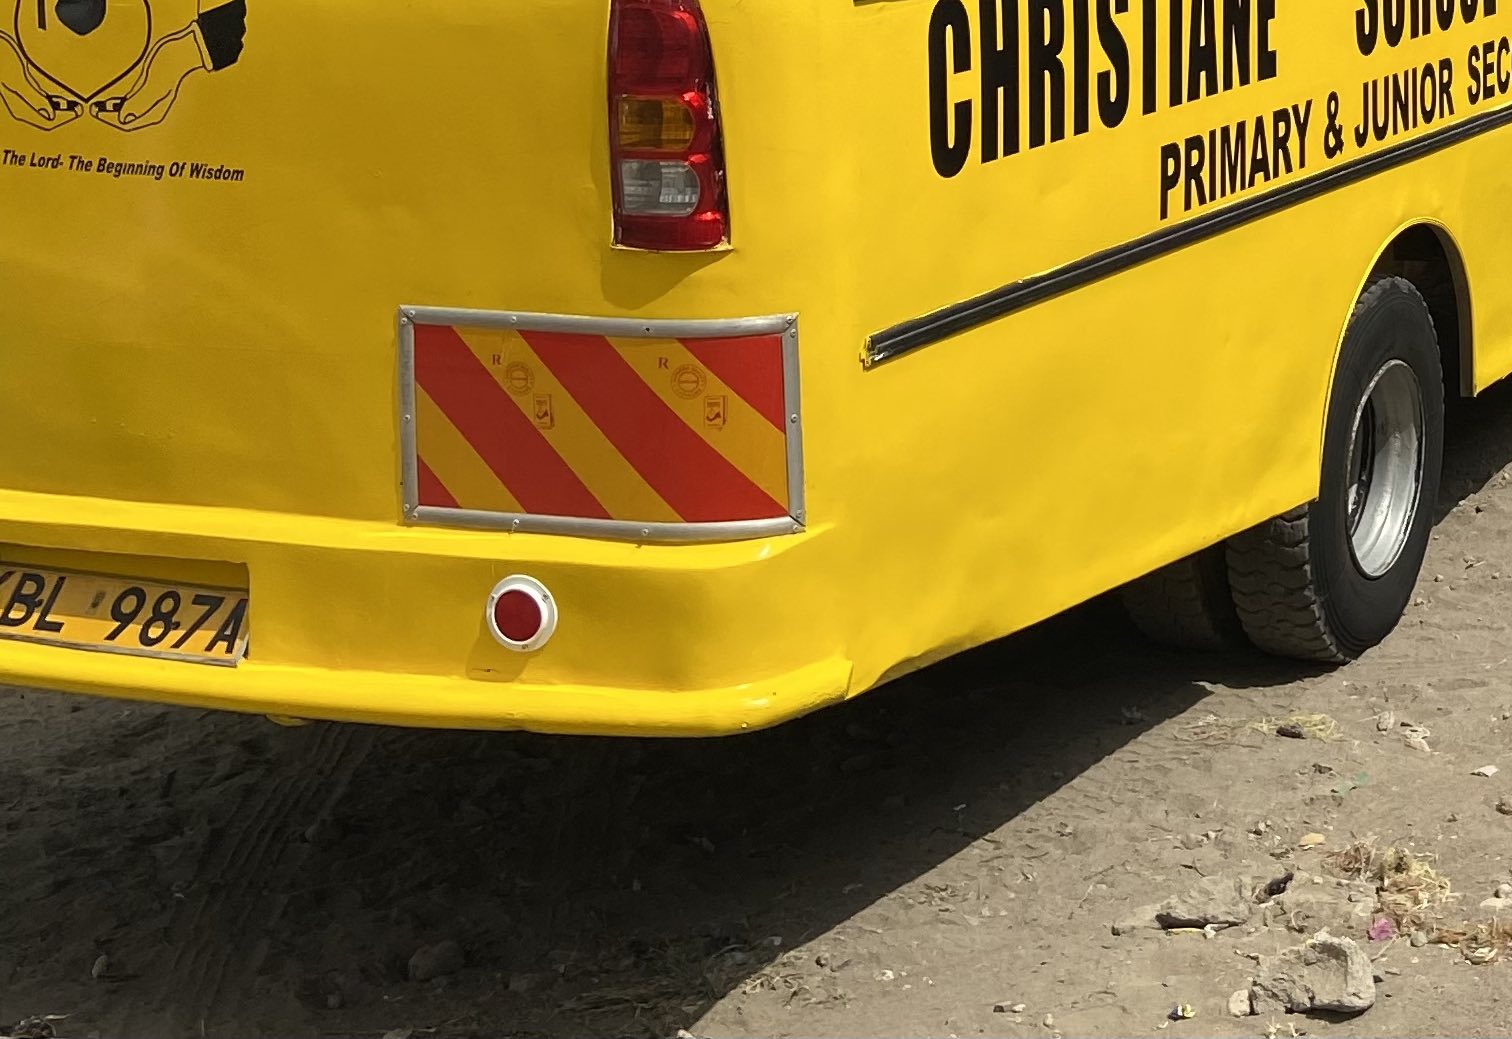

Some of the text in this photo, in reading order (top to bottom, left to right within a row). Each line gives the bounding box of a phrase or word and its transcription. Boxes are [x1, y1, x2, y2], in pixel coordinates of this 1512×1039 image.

[3, 149, 26, 166] The
[69, 154, 93, 172] The
[96, 157, 164, 181] Beginning
[169, 161, 187, 178] Of
[189, 164, 245, 182] Wisdom
[1160, 100, 1314, 220] PRIMARY
[1323, 91, 1344, 157] &
[1354, 58, 1455, 146] JUNIOR
[104, 586, 248, 655] 987A
